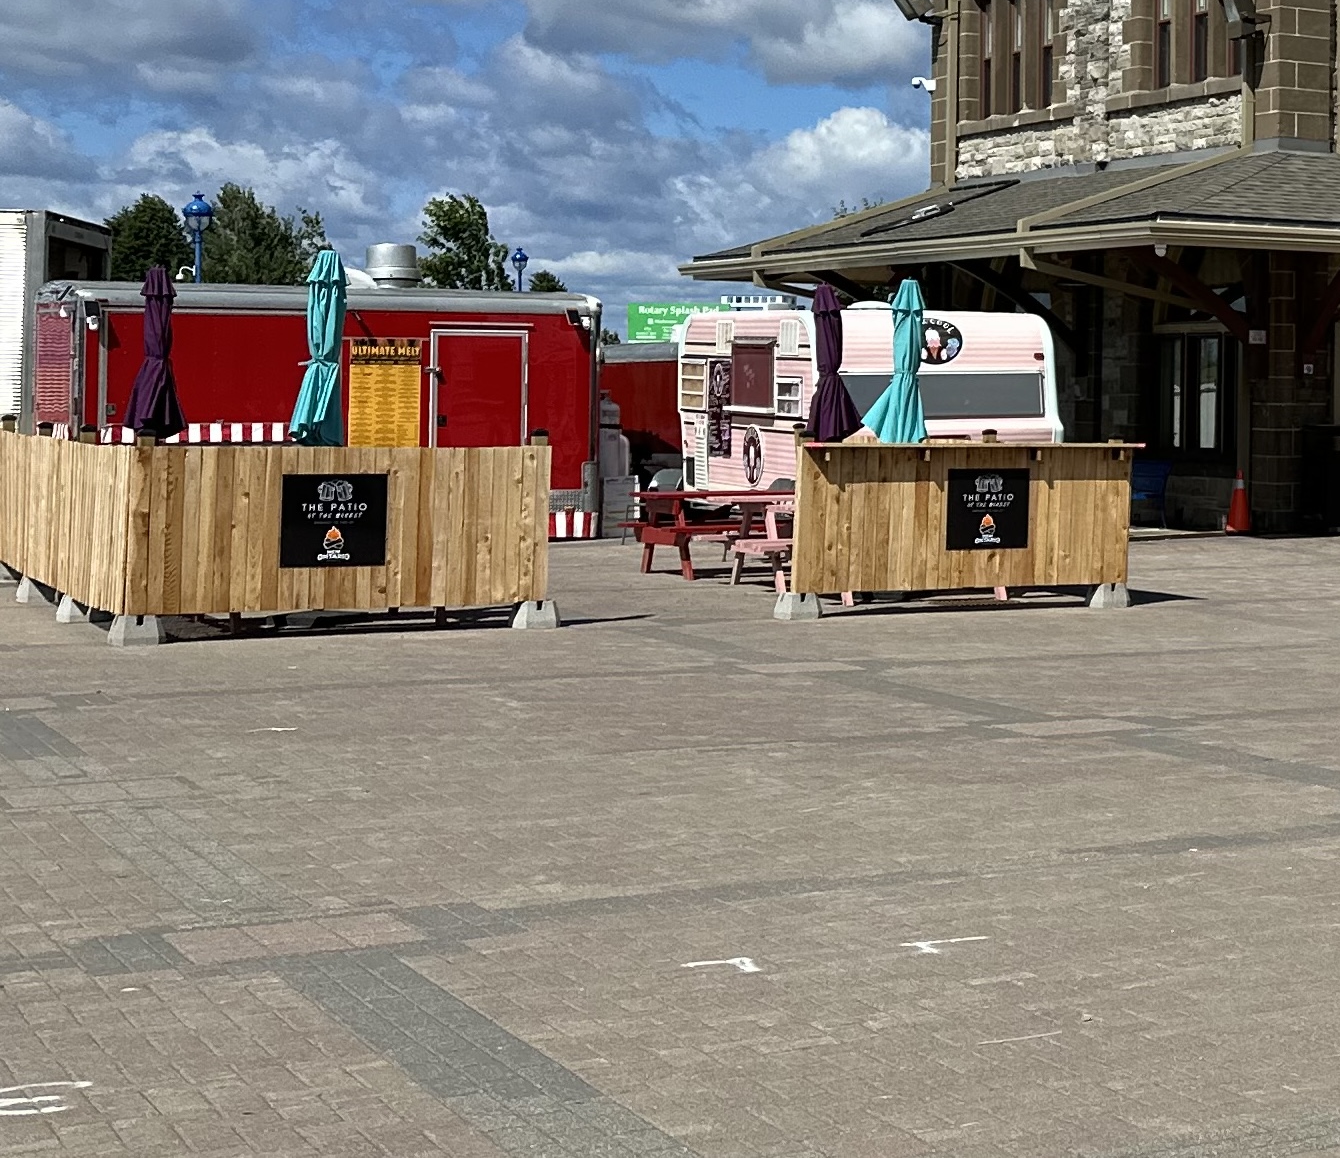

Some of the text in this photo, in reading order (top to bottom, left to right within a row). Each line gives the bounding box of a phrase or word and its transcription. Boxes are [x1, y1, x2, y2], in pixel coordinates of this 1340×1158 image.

[638, 305, 669, 317] Rotary
[669, 305, 701, 317] Splash
[351, 346, 420, 356] ULTIMATE MELT
[962, 493, 1014, 502] THE PATIO
[301, 502, 368, 512] THE PATIO
